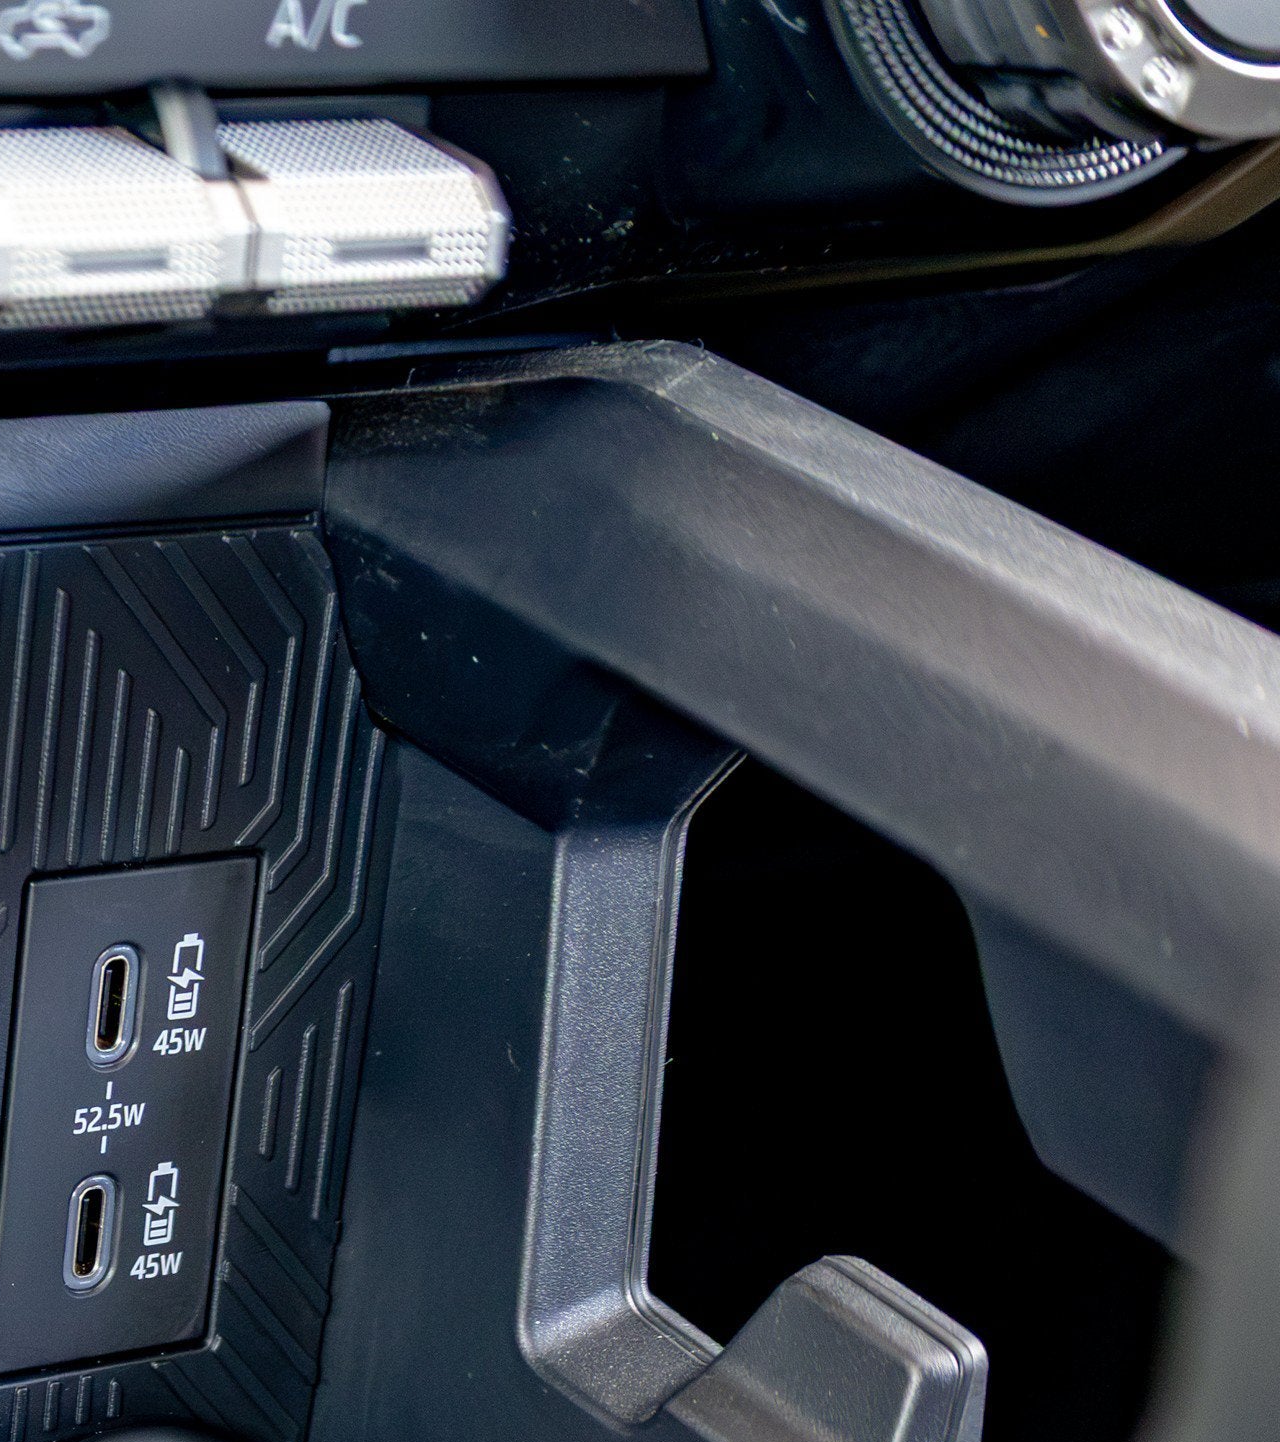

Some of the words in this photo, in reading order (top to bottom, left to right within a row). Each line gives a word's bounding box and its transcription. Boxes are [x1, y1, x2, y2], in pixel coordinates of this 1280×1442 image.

[264, 0, 363, 51] A/C
[152, 1027, 207, 1056] 45W
[72, 1102, 146, 1135] 52.5W
[130, 1251, 183, 1280] 45W
